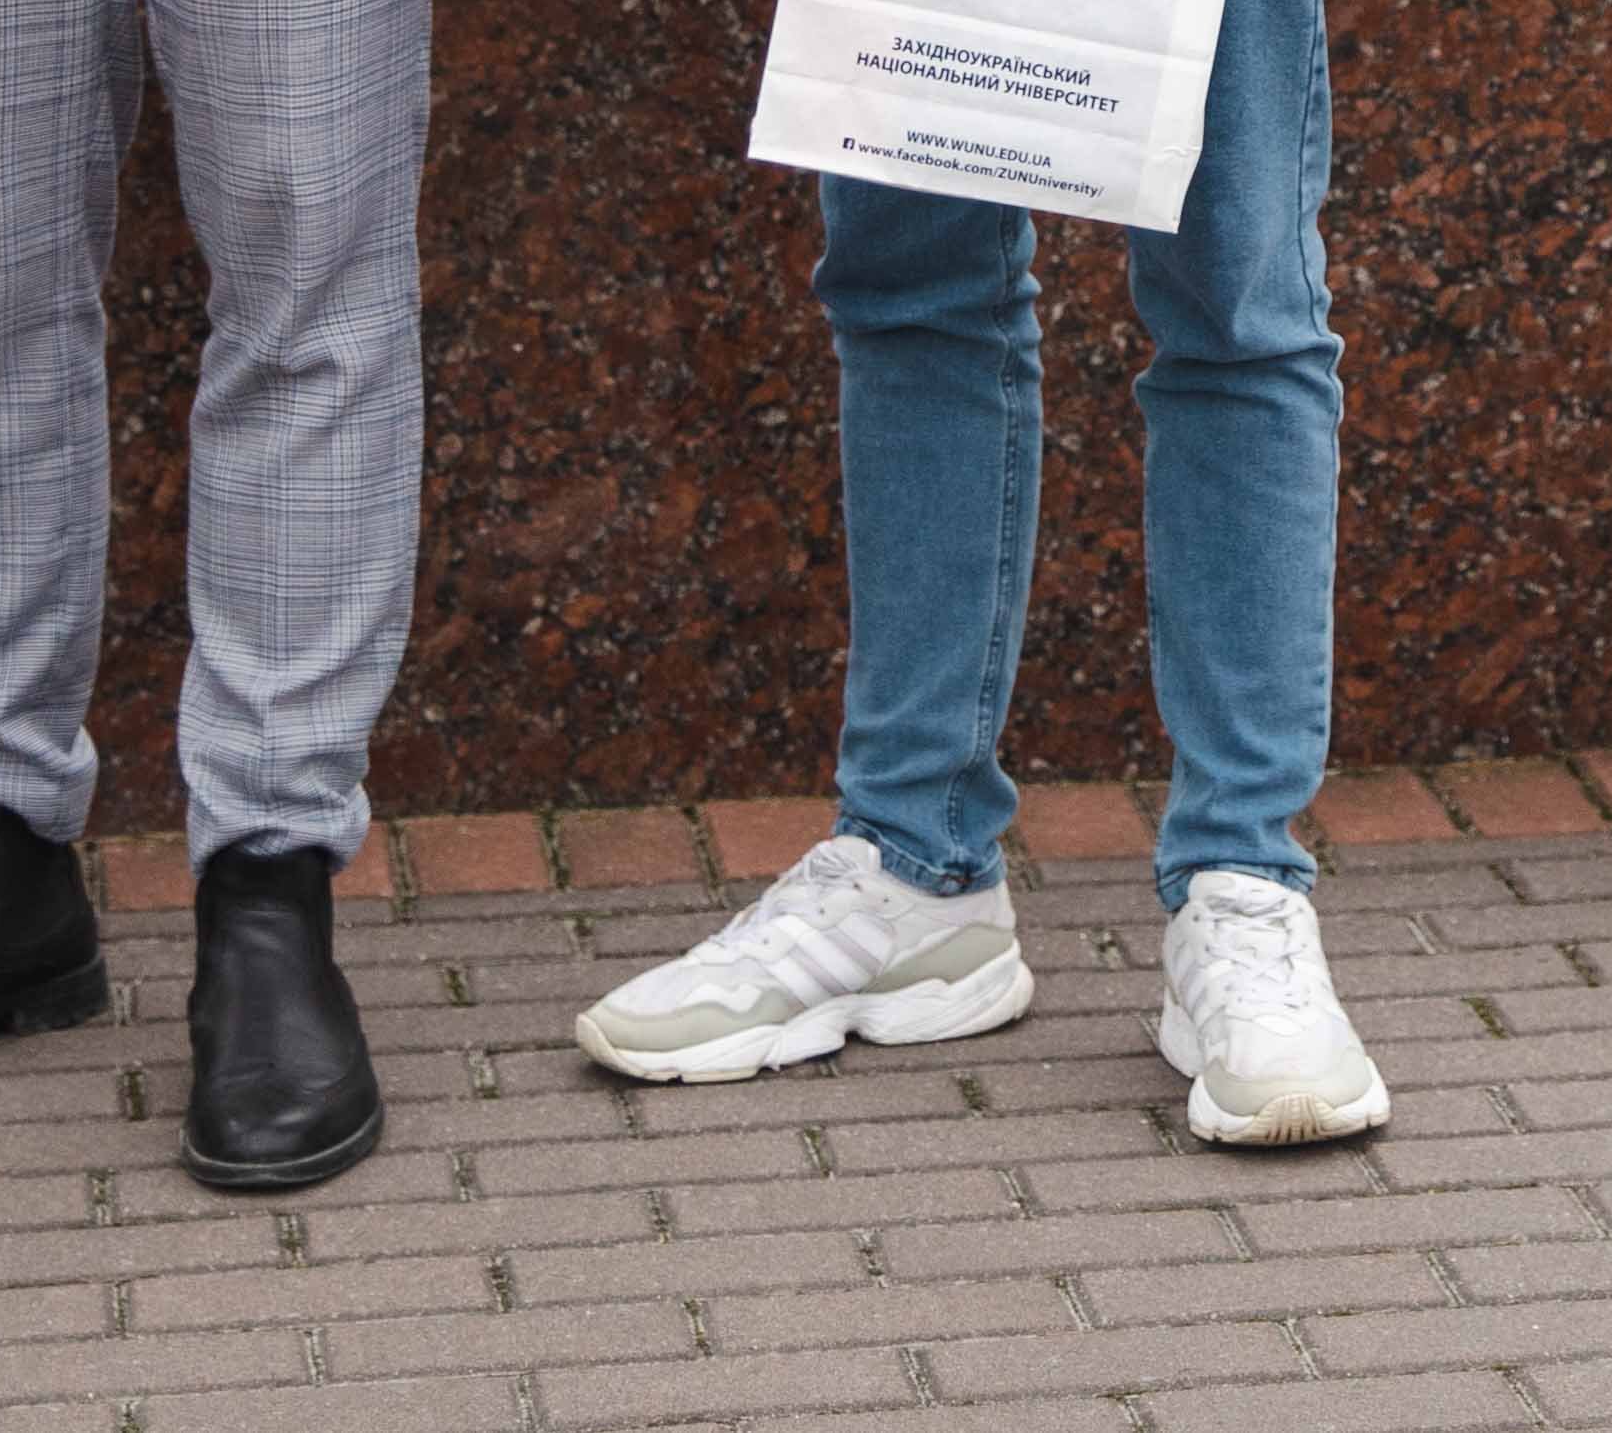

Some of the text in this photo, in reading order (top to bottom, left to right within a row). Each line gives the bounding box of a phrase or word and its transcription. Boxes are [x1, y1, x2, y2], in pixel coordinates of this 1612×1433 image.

[856, 51, 1120, 114] НАЦІОНАЛЬНИЙ УНІВЕРСИТЕТ
[891, 36, 1092, 87] ЗАХІДНОУКРАЇНСЬКИЙ
[858, 141, 1105, 199] www.facebook.com/ZUNUniversity/
[906, 130, 1052, 169] WWW.WUNU.EDU.UA
